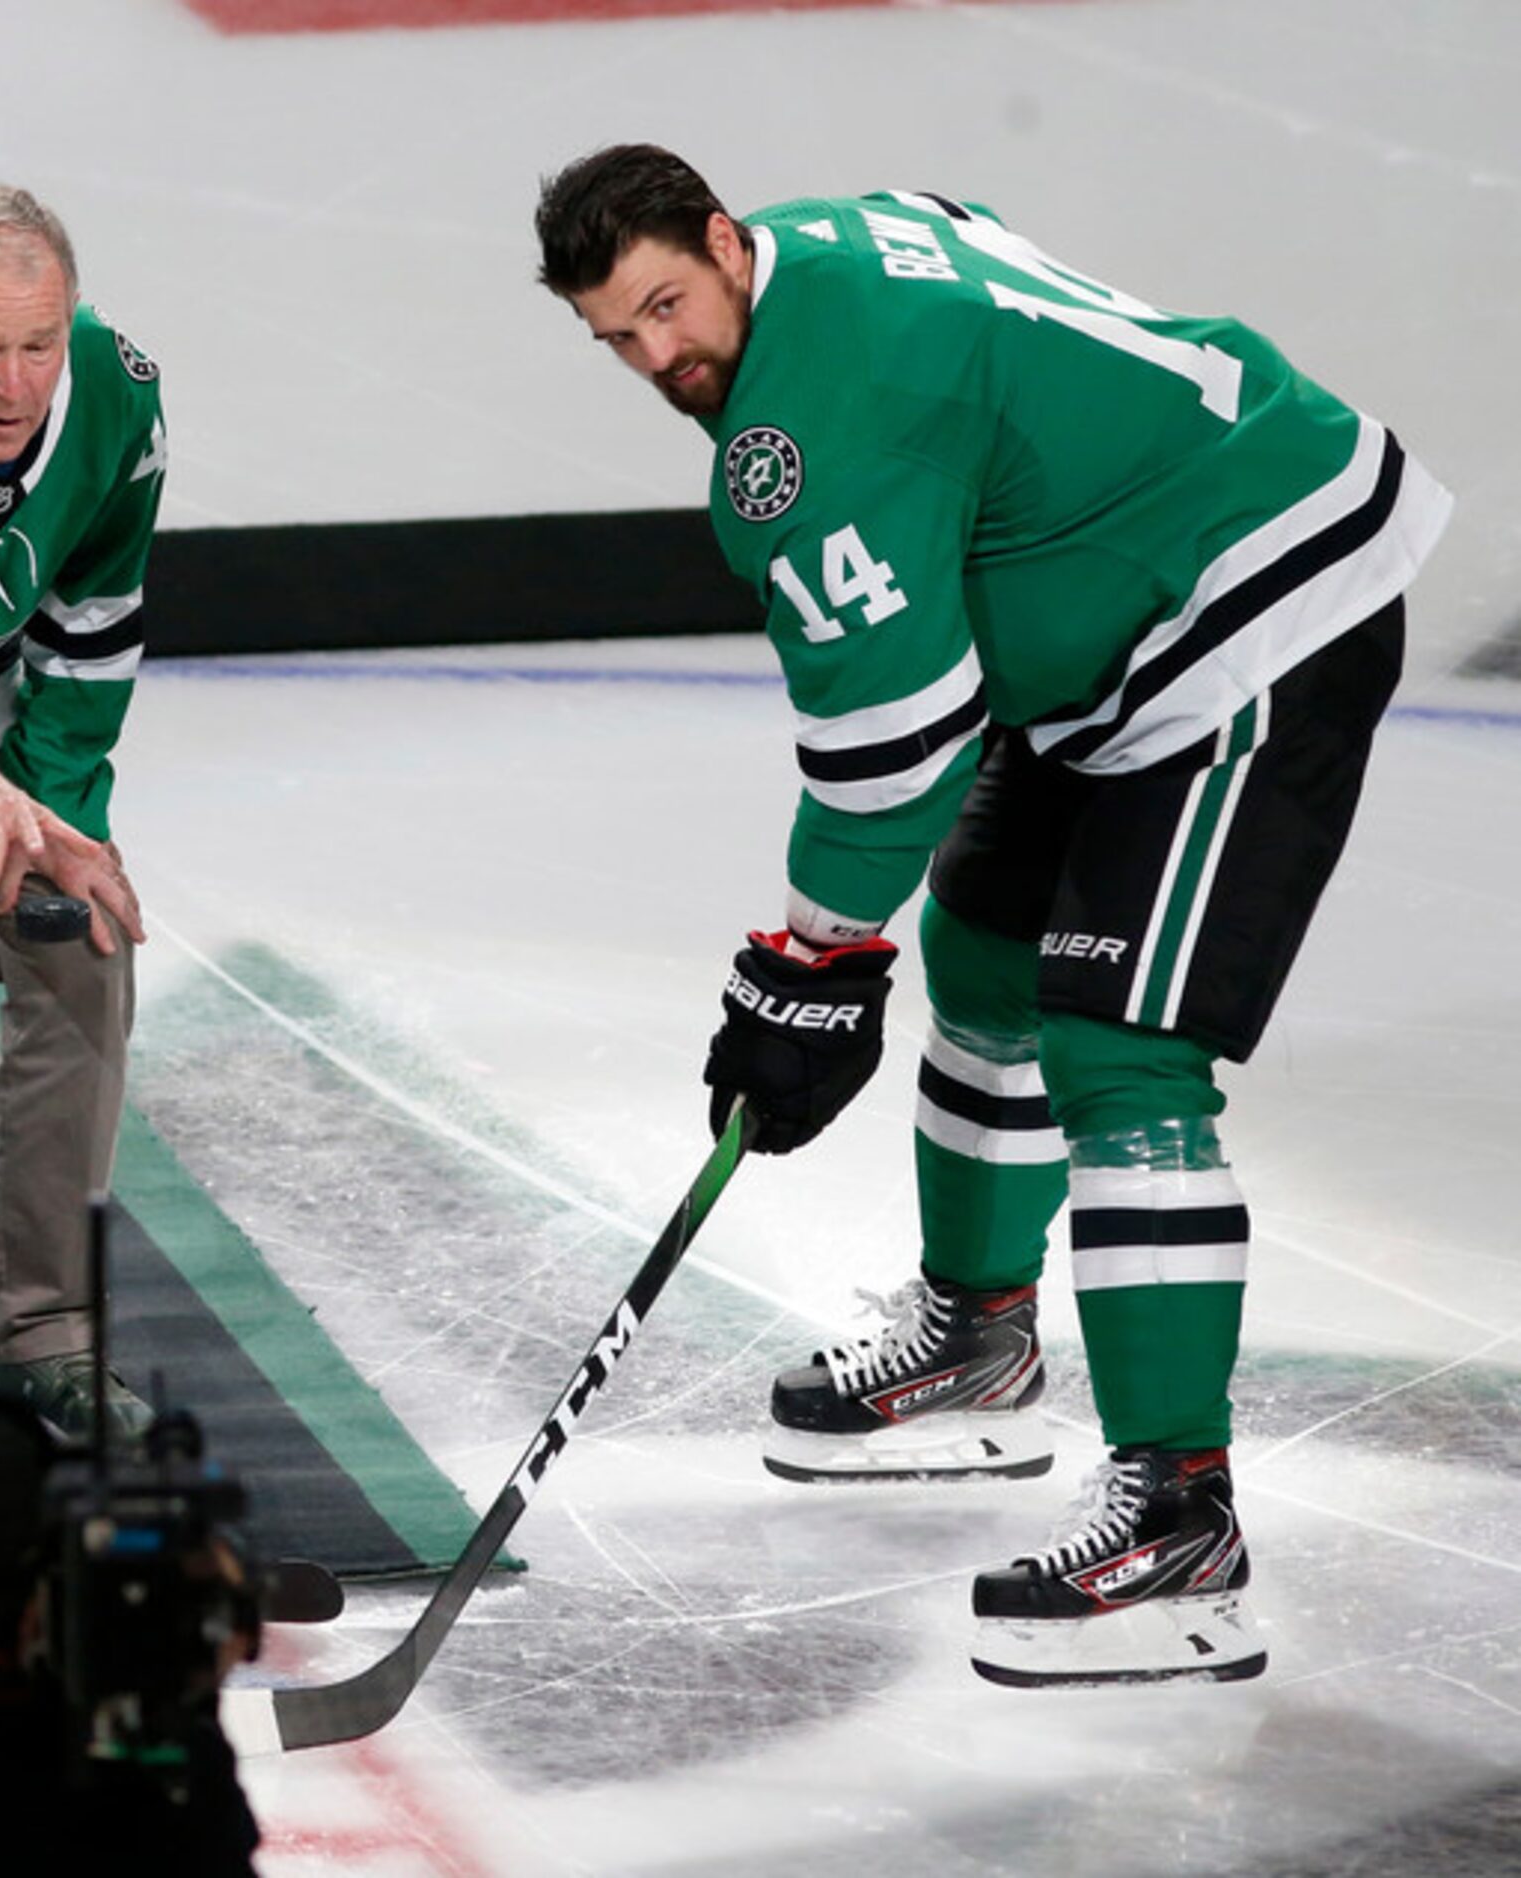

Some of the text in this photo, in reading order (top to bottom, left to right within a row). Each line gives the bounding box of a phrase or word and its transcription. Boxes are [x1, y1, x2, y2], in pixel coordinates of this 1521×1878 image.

[769, 523, 909, 643] 14
[510, 1299, 641, 1505] CCM
[1095, 1548, 1157, 1593] CCM
